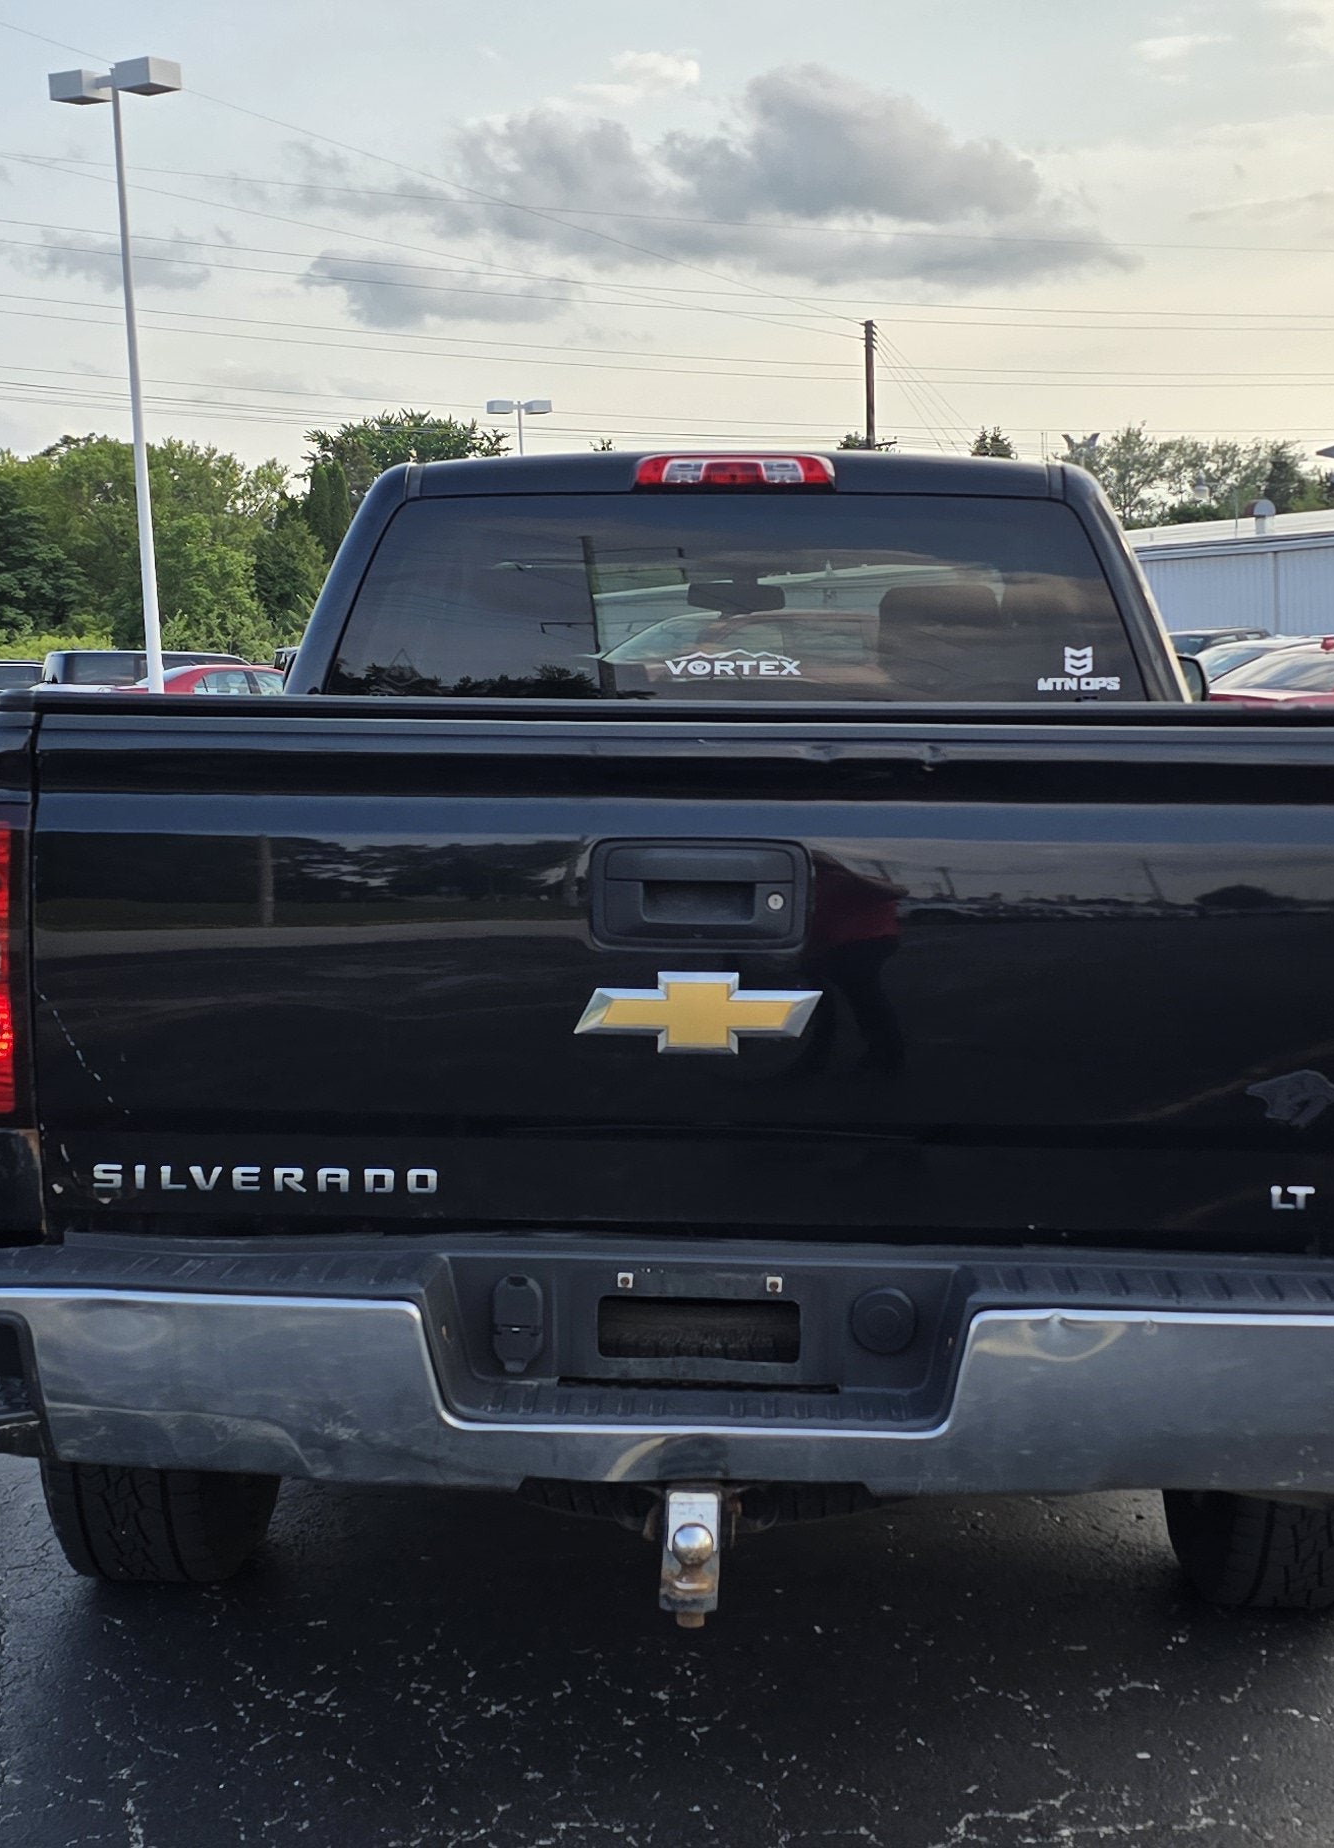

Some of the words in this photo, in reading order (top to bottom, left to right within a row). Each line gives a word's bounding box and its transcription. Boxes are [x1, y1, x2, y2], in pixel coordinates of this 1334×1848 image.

[665, 660, 802, 676] VORTEX
[1037, 677, 1078, 691] MTN
[1080, 676, 1121, 690] OPS
[93, 1163, 438, 1193] SILVERADO
[1270, 1185, 1316, 1210] LT
